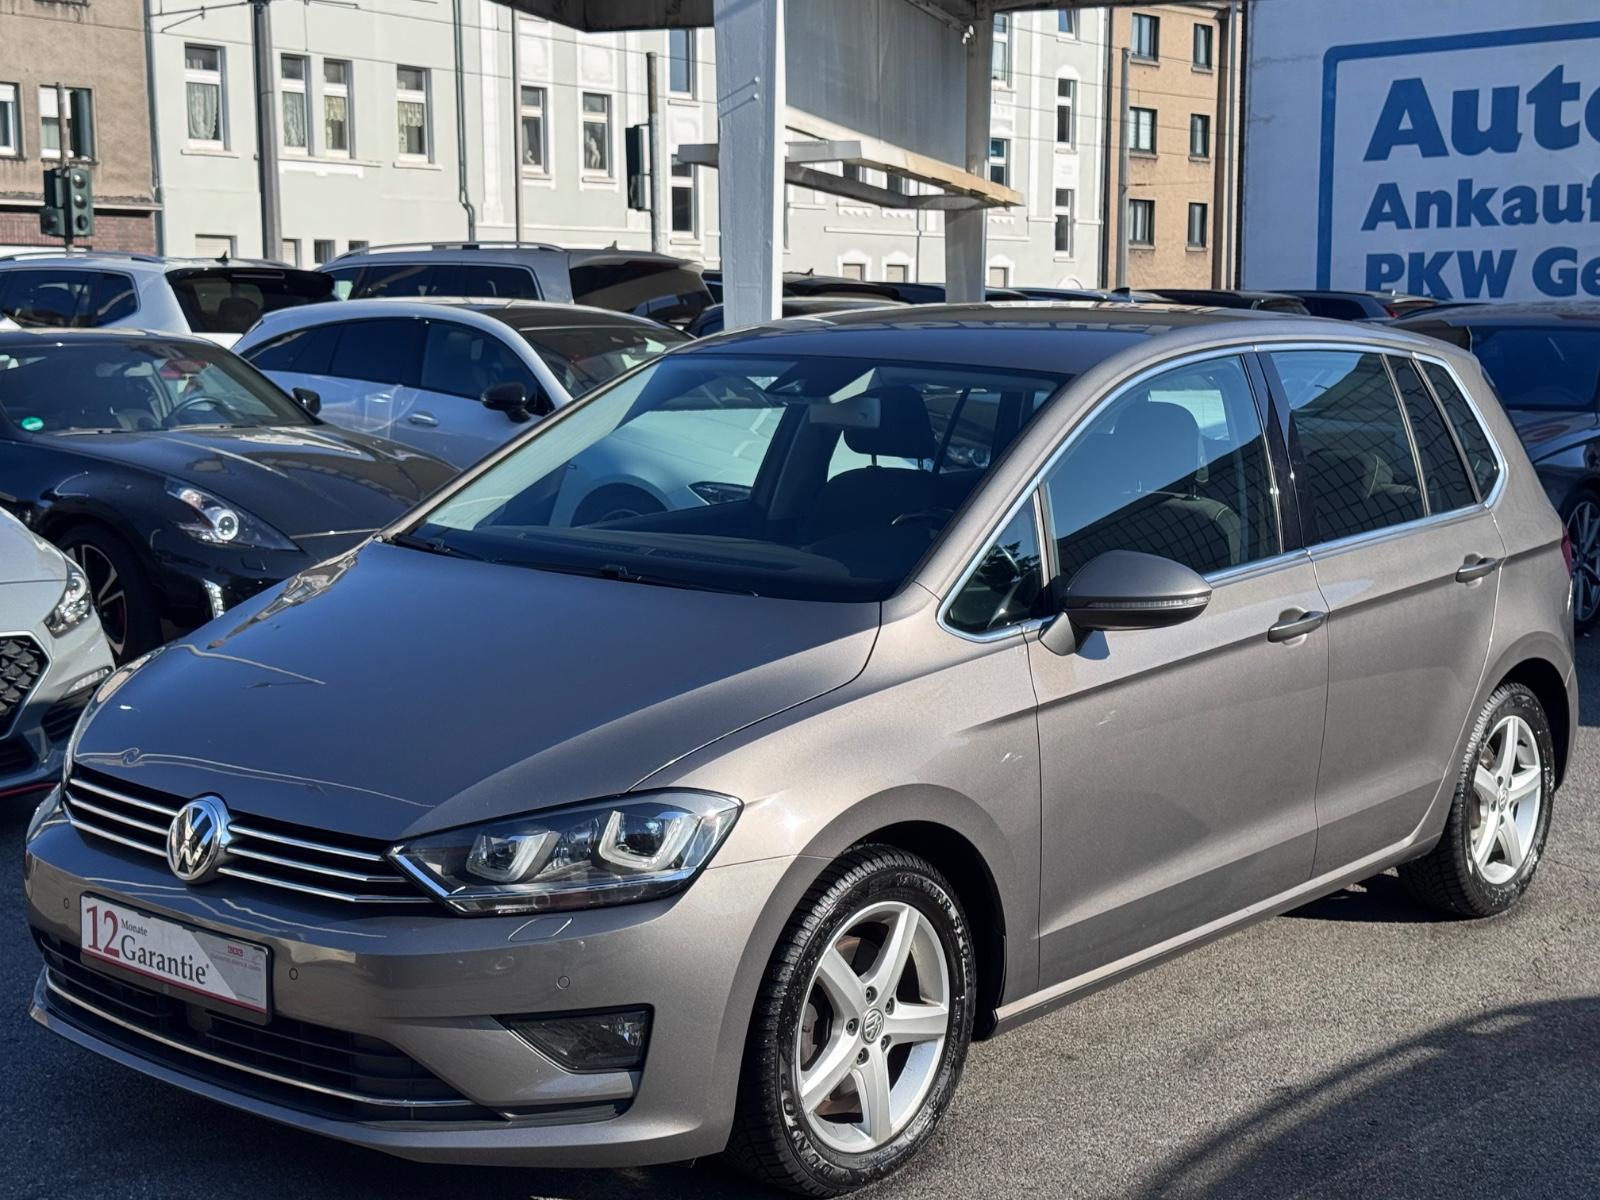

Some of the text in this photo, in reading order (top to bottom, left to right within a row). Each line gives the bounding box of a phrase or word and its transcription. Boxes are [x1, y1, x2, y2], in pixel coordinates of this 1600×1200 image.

[1363, 64, 1600, 162] Aut
[1365, 249, 1517, 299] PKW
[86, 905, 120, 959] 12
[121, 918, 148, 937] Monate
[780, 1072, 835, 1177] DUNLOP
